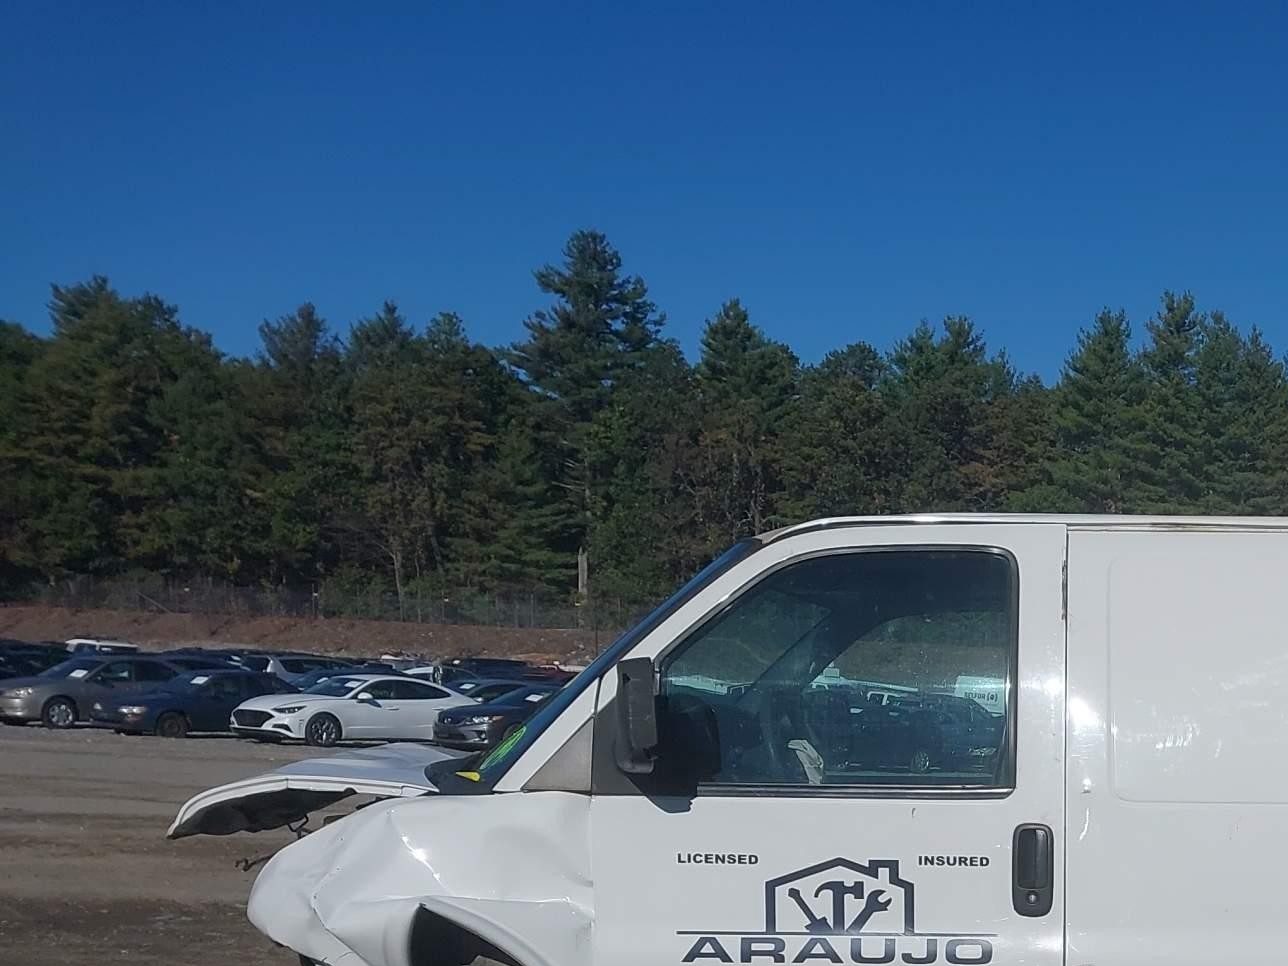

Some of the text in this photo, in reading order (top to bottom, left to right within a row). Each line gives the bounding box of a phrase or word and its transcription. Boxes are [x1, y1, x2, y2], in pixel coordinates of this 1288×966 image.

[677, 853, 759, 865] LICENSED
[918, 855, 990, 867] INSURED
[681, 936, 993, 965] ARAUJO
